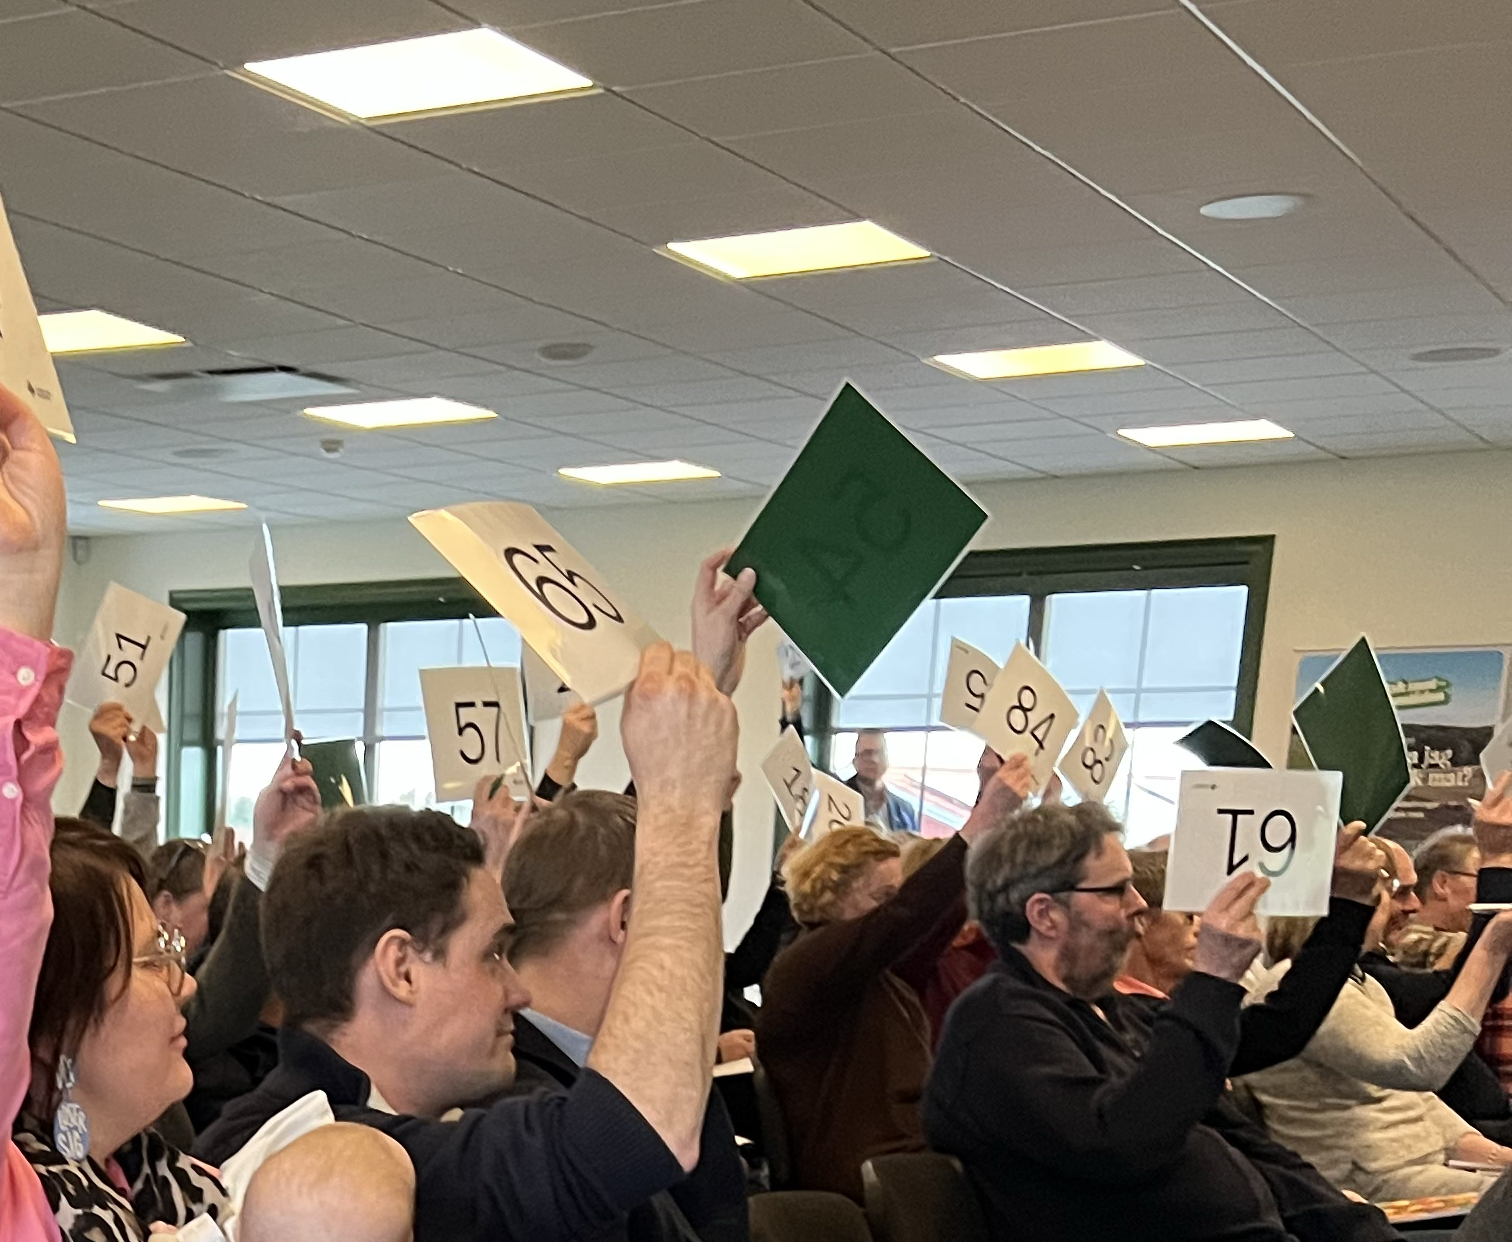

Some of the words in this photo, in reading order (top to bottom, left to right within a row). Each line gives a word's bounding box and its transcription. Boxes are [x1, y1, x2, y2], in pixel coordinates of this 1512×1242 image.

[504, 544, 624, 630] 65
[101, 630, 151, 688] 51
[454, 700, 502, 765] 57
[1006, 685, 1057, 757] 84
